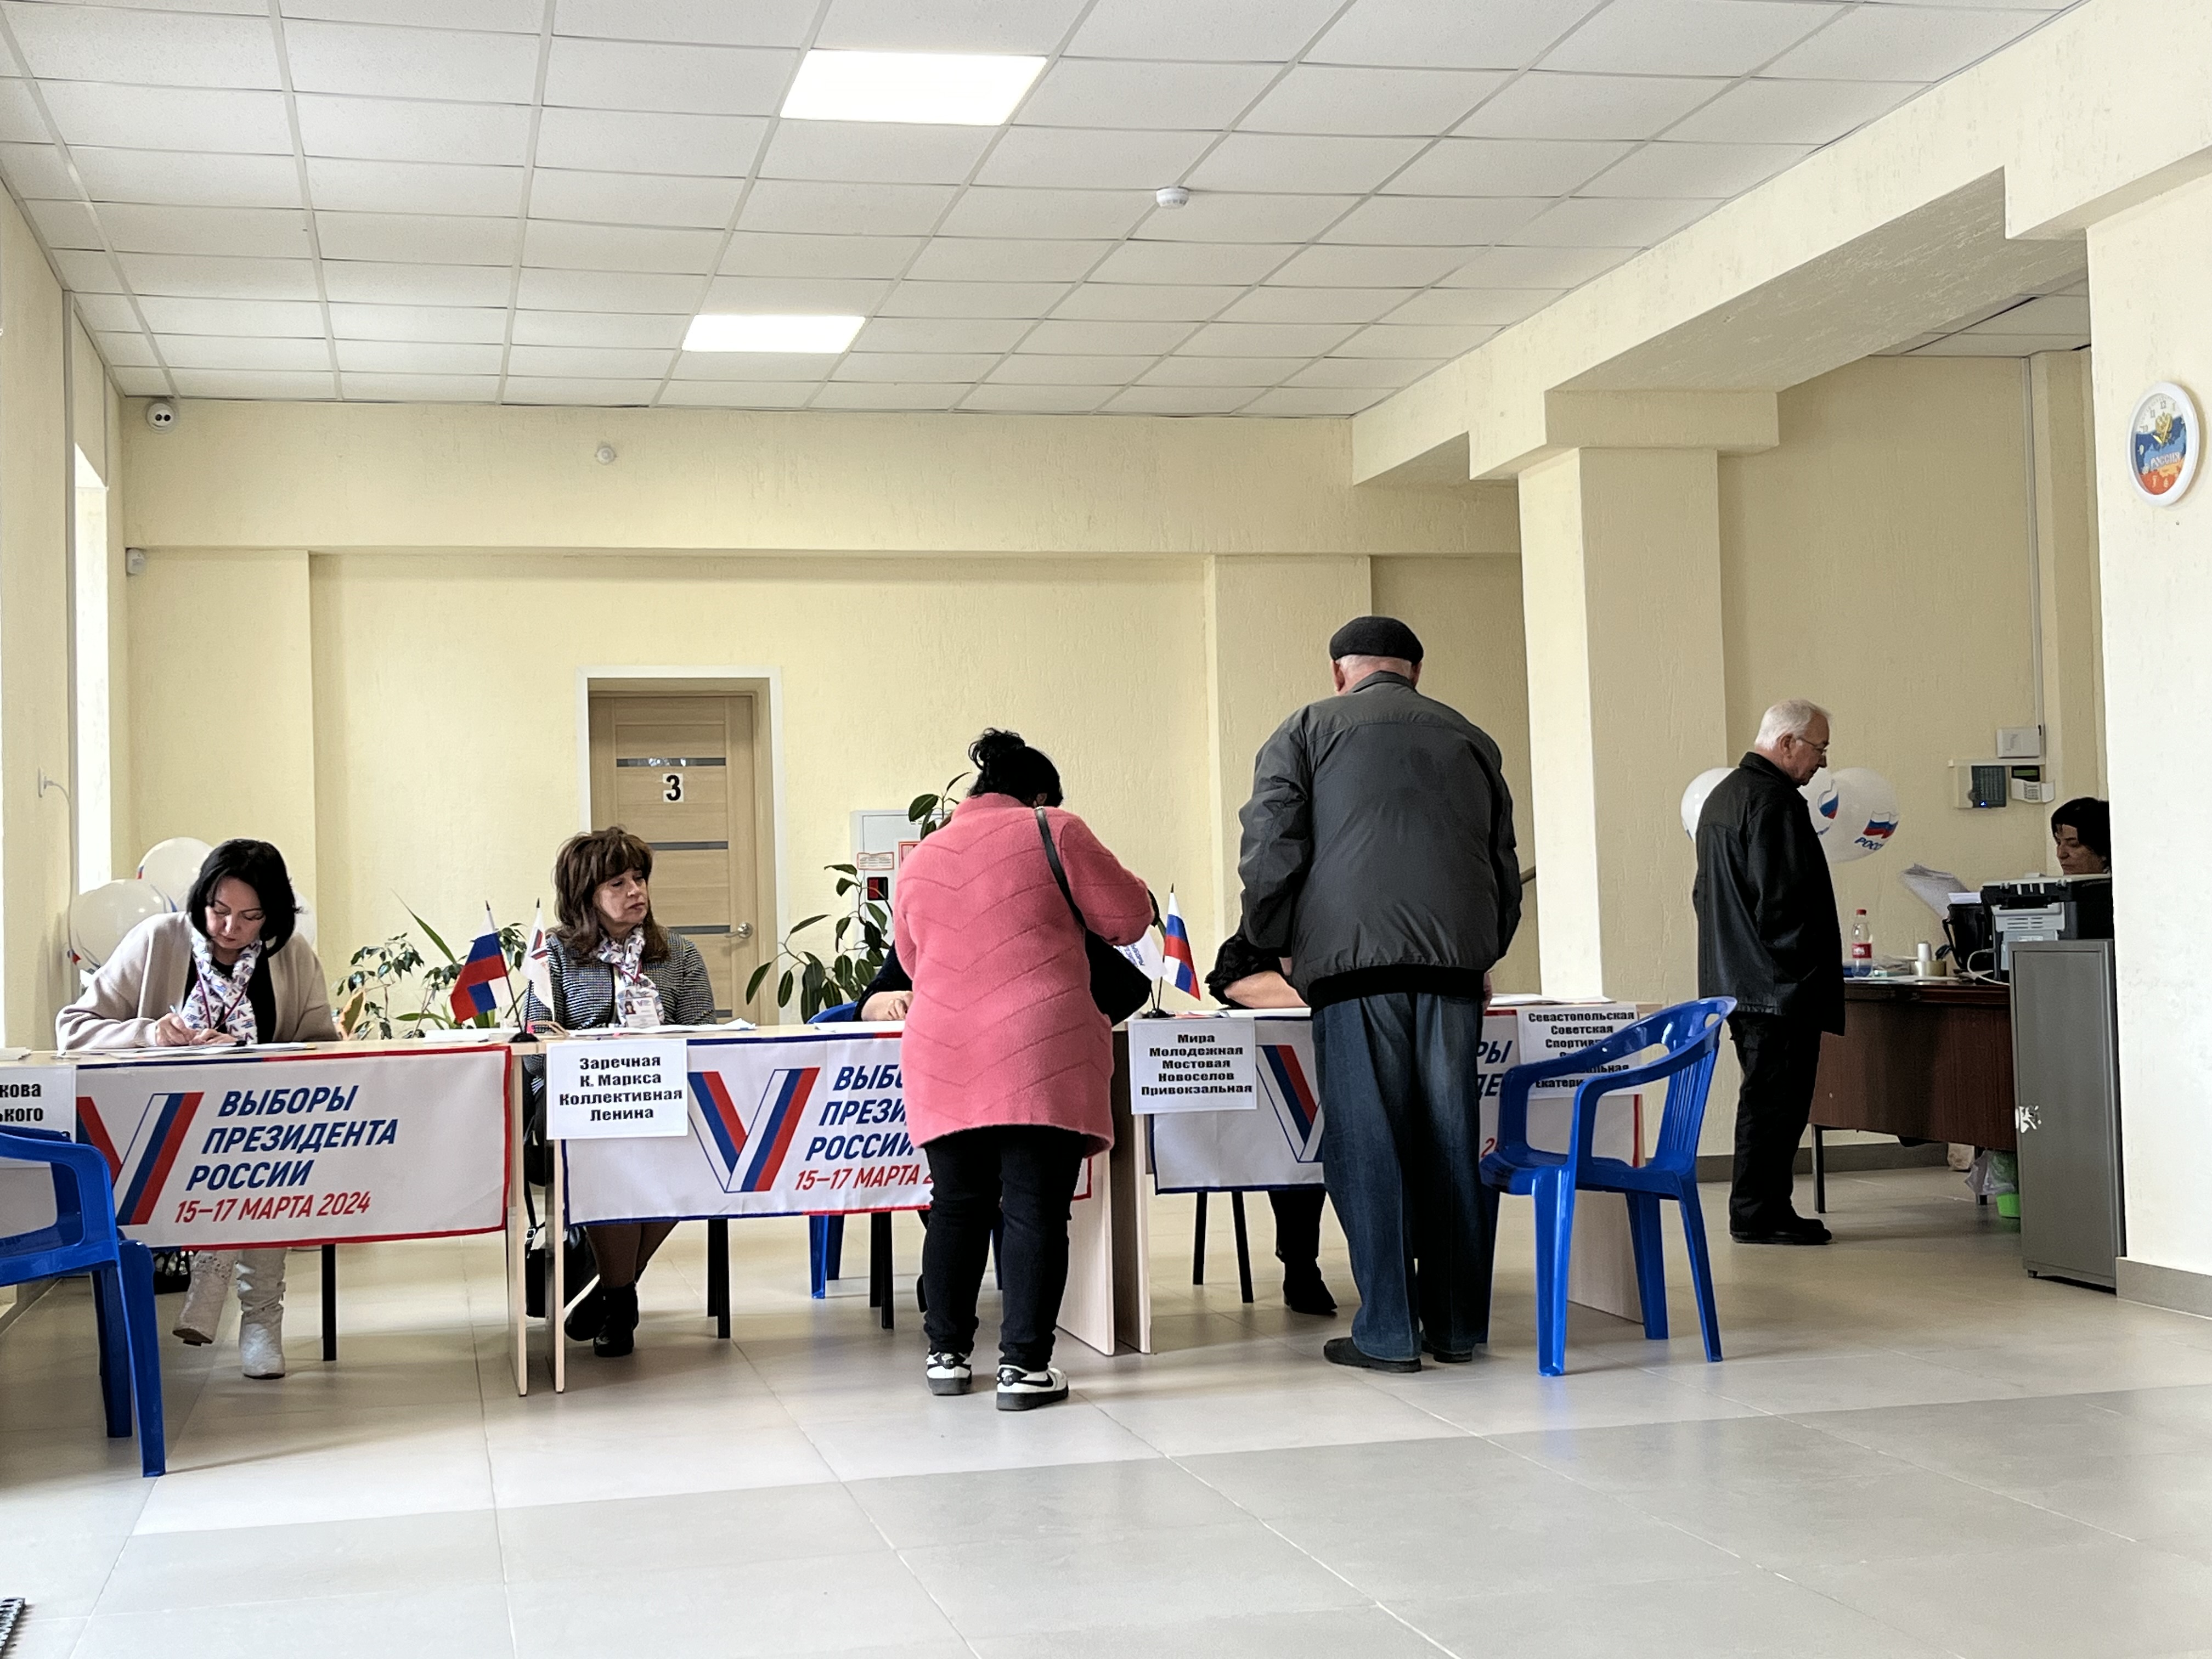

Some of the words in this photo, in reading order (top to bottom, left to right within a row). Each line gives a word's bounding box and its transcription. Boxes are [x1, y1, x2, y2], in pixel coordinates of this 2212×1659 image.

[666, 774, 681, 801] 3
[1528, 1012, 1635, 1023] Севастопольская
[1550, 1025, 1613, 1035] Советская
[1177, 1034, 1215, 1044] Мира
[1149, 1047, 1244, 1058] Молодежная
[579, 1056, 661, 1070] Заречная
[1162, 1059, 1231, 1069] Мостовая
[580, 1075, 594, 1087] К.
[598, 1074, 662, 1086] Маркса
[832, 1064, 903, 1091] ВЫБ
[1158, 1073, 1235, 1082] Новоселов
[559, 1089, 683, 1106] Коллективная
[1141, 1085, 1252, 1096] Привокзальная
[217, 1085, 360, 1117] ВЫБОРЫ
[590, 1108, 654, 1121] Ленина
[818, 1098, 907, 1126] ПРЕЗИ
[201, 1119, 399, 1154] ПРЕЗИДЕНТА
[805, 1132, 915, 1161] РОССИИ
[185, 1159, 315, 1192] РОССИИ
[853, 1164, 921, 1189] МАРТА
[238, 1194, 314, 1221] МАРТА
[316, 1190, 372, 1217] 2024
